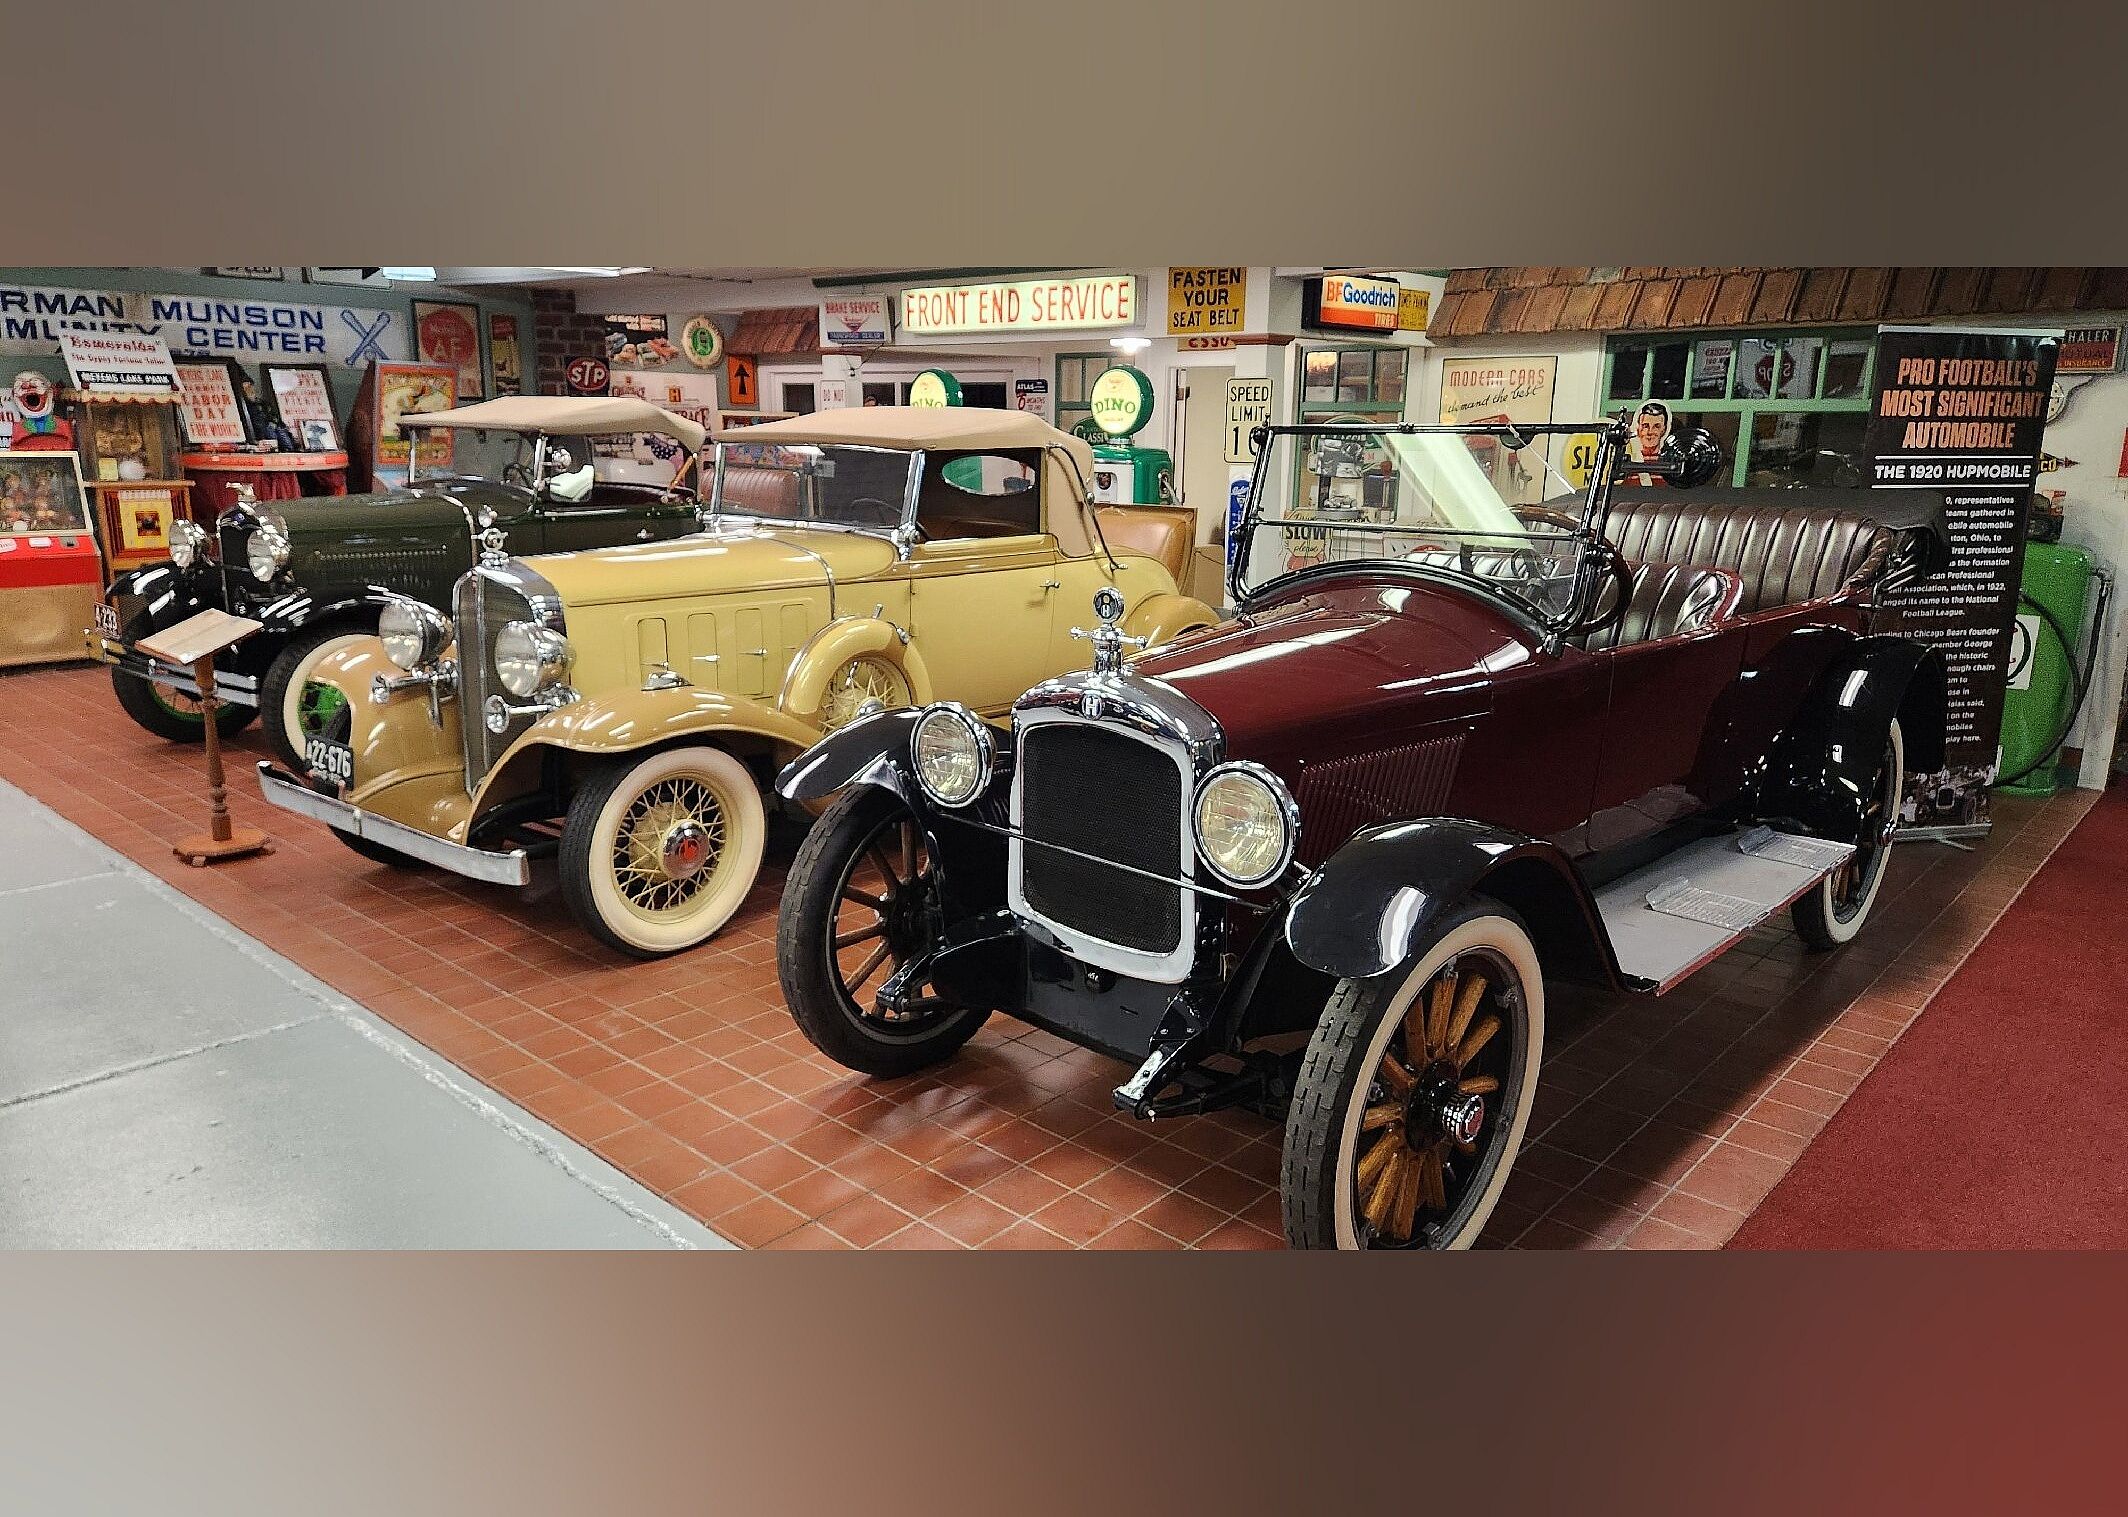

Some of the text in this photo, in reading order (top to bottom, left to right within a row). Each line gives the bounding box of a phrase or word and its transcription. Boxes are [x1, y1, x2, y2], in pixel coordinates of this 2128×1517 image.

[1173, 267, 1241, 288] FASTEN
[1184, 288, 1228, 307] YOUR
[1327, 280, 1396, 308] BFGoodrich
[849, 301, 880, 314] SERVICE
[906, 281, 1129, 327] FRONT END SERVICE
[152, 299, 323, 330] MUNSON
[1173, 308, 1240, 327] SEAT BELT
[186, 326, 326, 354] CENTER
[2062, 330, 2109, 343] HALER
[571, 361, 605, 387] STP
[1450, 369, 1545, 387] MODERN CARS
[1897, 358, 2039, 387] PRO FOOTBALL'S
[1230, 386, 1269, 402] SPEED
[1492, 387, 1508, 403] the
[1095, 397, 1136, 414] DINO
[1880, 390, 2046, 418] MOST SIGNIFICANT
[1231, 406, 1265, 422] LIMIT
[1902, 420, 2016, 449] AUTOMOBILE
[1572, 445, 1593, 470] SL
[1874, 464, 2032, 479] THE 1920 HUPMOBILE
[1955, 496, 2015, 505] representatives
[1970, 508, 2006, 519] gathered
[2007, 508, 2015, 516] in
[1285, 525, 1327, 540] SLOW
[1969, 521, 2014, 530] automobile
[1970, 533, 1992, 542] Ohio,
[1966, 546, 2014, 555] professional
[1958, 559, 1971, 567] the
[1972, 558, 2010, 567] formation
[1947, 570, 1995, 580] Professional
[1904, 584, 1949, 593] Association,
[1950, 582, 1975, 593] which,
[1976, 583, 1985, 591] in
[1919, 597, 1941, 605] name
[1942, 596, 1949, 604] to
[1951, 596, 1964, 604] the
[1965, 595, 1999, 604] National
[1903, 609, 1965, 618] Football League.
[1904, 629, 1912, 638] to
[1913, 629, 1945, 639] Chicago
[1946, 628, 1967, 637] Bears
[1968, 627, 2000, 636] founder
[1964, 639, 1993, 649] George
[1959, 651, 1989, 660] historic
[1972, 663, 1996, 672] chairs
[1963, 687, 1970, 695] in
[1962, 711, 1975, 719] the
[1945, 735, 1961, 745] play
